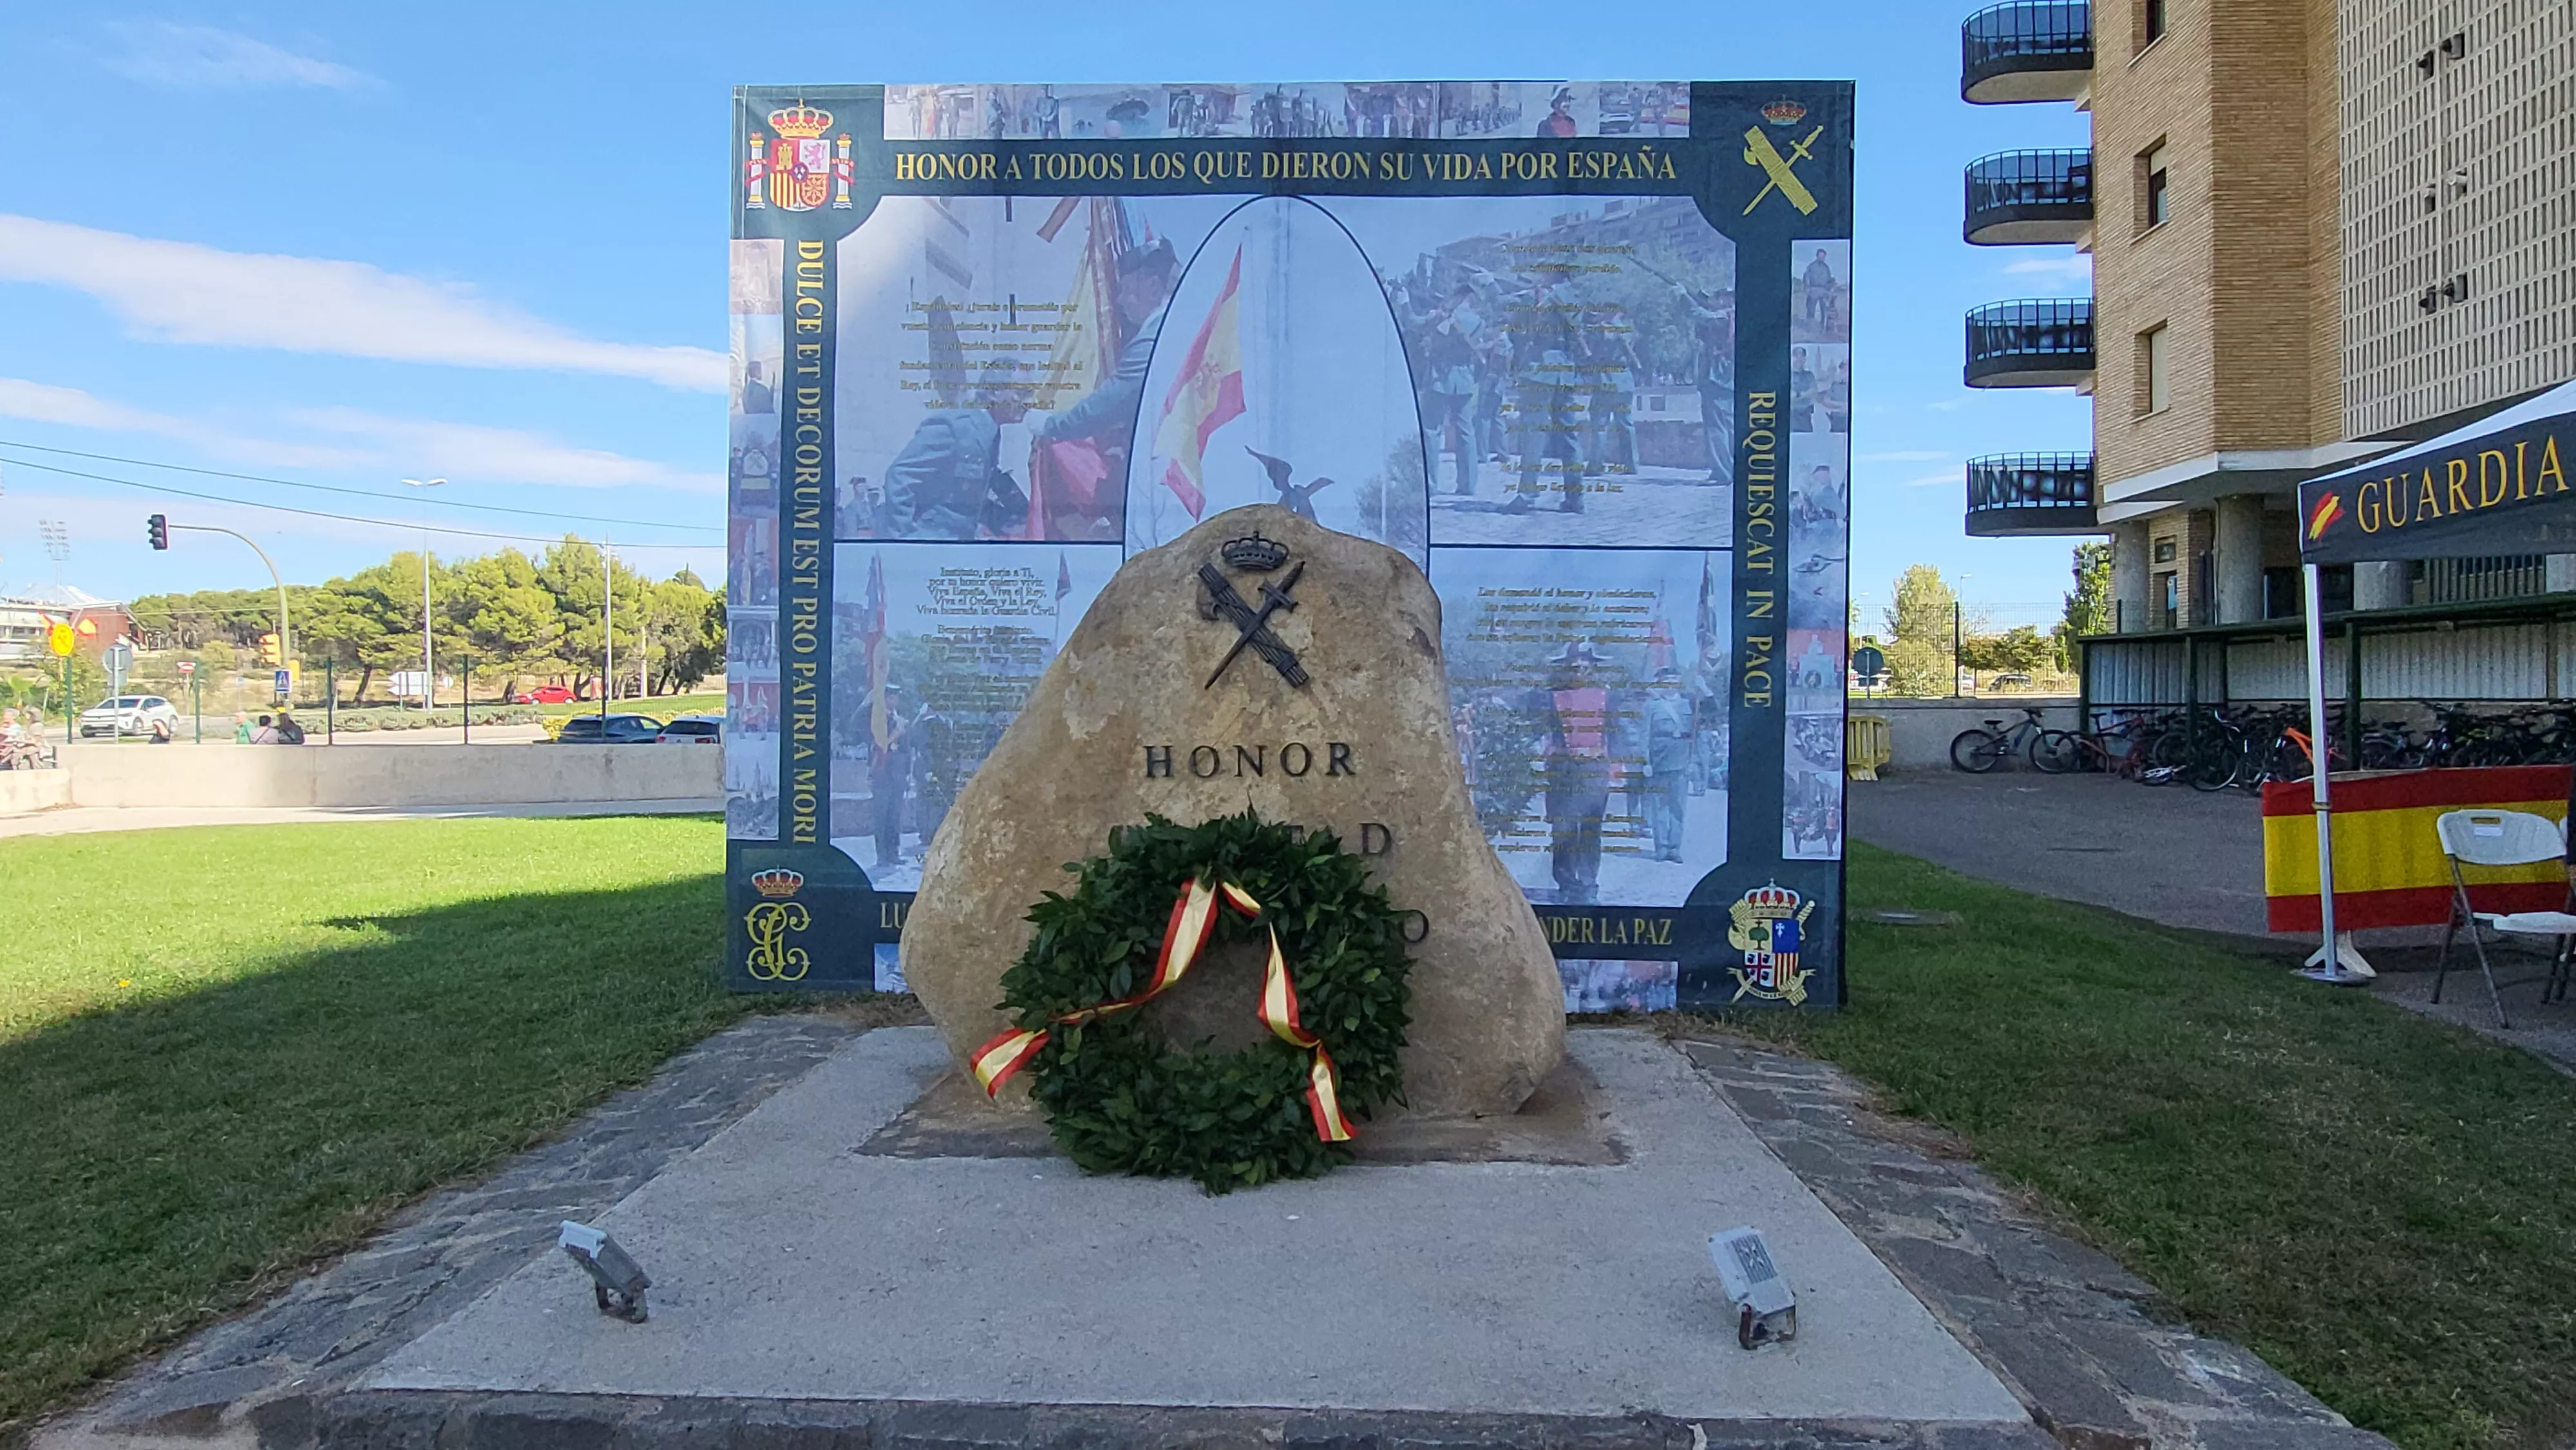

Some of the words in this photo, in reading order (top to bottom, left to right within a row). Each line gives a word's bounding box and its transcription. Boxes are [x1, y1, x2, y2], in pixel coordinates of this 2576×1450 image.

[896, 153, 998, 180] HONOR
[1004, 154, 1023, 179] A
[1028, 153, 1124, 180] TODOS
[1132, 152, 1186, 180] LOS
[1193, 151, 1253, 184] QUE
[1261, 151, 1371, 180] DIERON
[1379, 152, 1415, 180] SU
[1422, 153, 1493, 180] VIDA
[1500, 152, 1558, 180] POR
[1567, 146, 1676, 180] ESPAÑA
[795, 240, 824, 334] DULCE
[796, 343, 822, 379] ET
[794, 386, 822, 530] DECORUM
[1743, 390, 1776, 575] REQUIESCAT
[2356, 434, 2570, 534] GUARDIA
[792, 538, 820, 589] EST
[792, 597, 819, 654] PRO
[916, 605, 938, 614] Viva
[1746, 589, 1774, 619] IN
[1743, 635, 1773, 708] PACE
[792, 661, 818, 761] PATRIA
[1144, 741, 1356, 778] HONOR
[793, 769, 817, 844] MORI
[880, 901, 906, 928] LU
[1539, 916, 1595, 943] NDER
[1600, 917, 1628, 945] LA
[1634, 918, 1673, 945] PAZ
